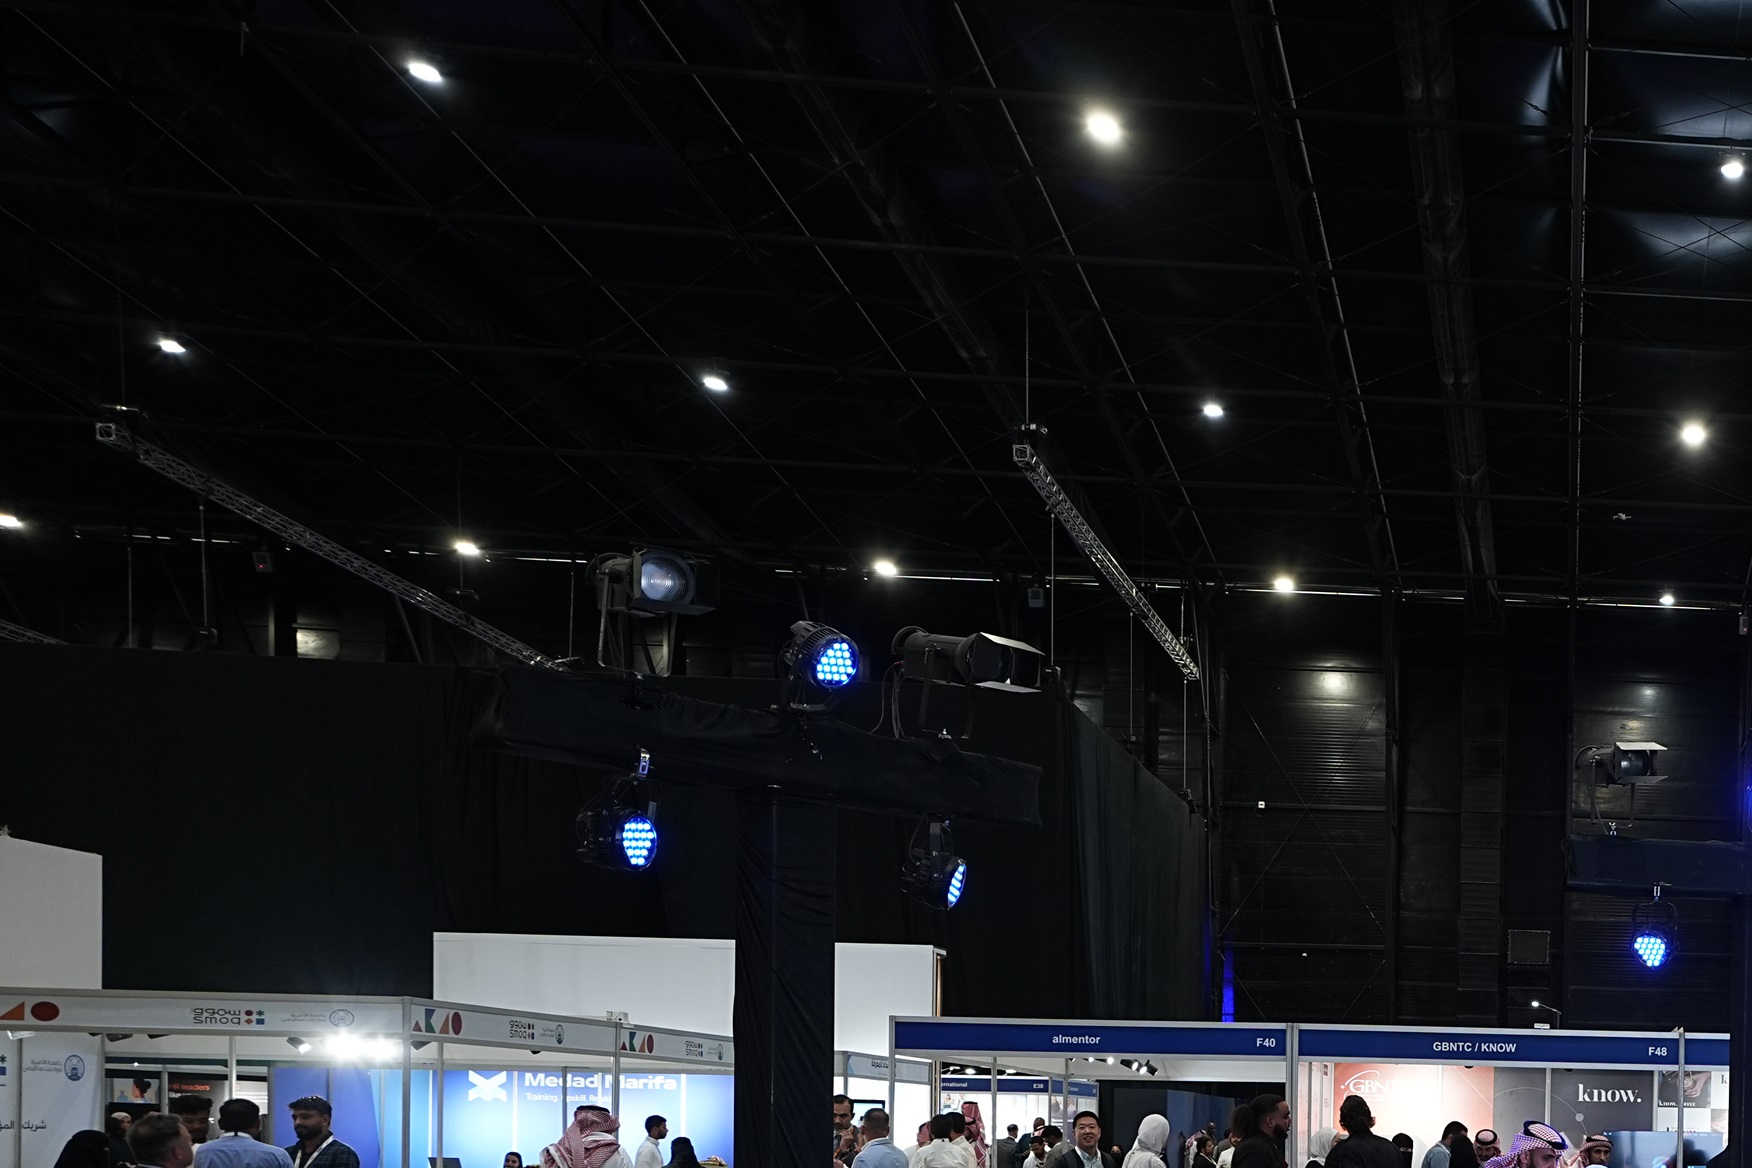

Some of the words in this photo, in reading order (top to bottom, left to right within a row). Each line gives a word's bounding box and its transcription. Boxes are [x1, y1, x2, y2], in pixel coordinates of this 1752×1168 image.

[193, 1016, 241, 1026] smoq
[1052, 1033, 1101, 1045] almentor
[1256, 1037, 1276, 1048] F40
[1432, 1041, 1472, 1052] GBNTC
[1481, 1042, 1517, 1053] KNOW
[1648, 1046, 1668, 1057] F48
[181, 1083, 210, 1091] leaders
[604, 1074, 678, 1091] Marifa
[1349, 1079, 1398, 1094] GBNT
[563, 1094, 588, 1102] pskill.
[1577, 1083, 1642, 1103] know.
